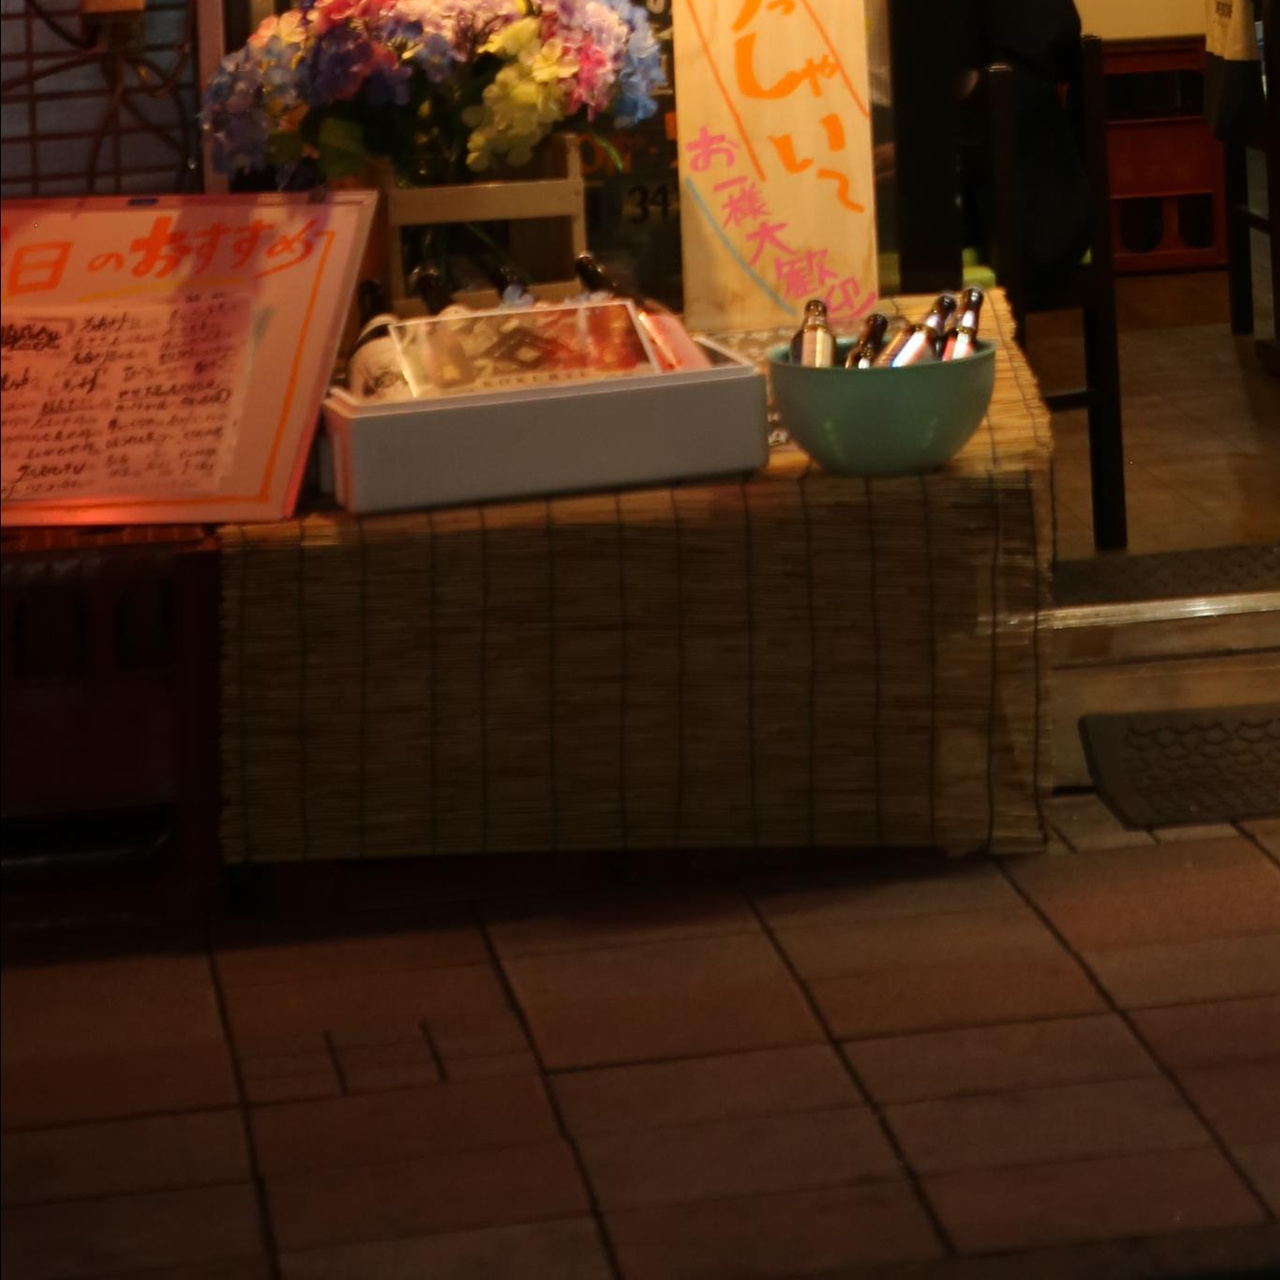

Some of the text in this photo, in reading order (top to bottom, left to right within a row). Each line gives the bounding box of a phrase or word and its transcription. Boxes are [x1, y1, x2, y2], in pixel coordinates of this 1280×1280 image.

[1, 215, 315, 297] 日のおすすめ
